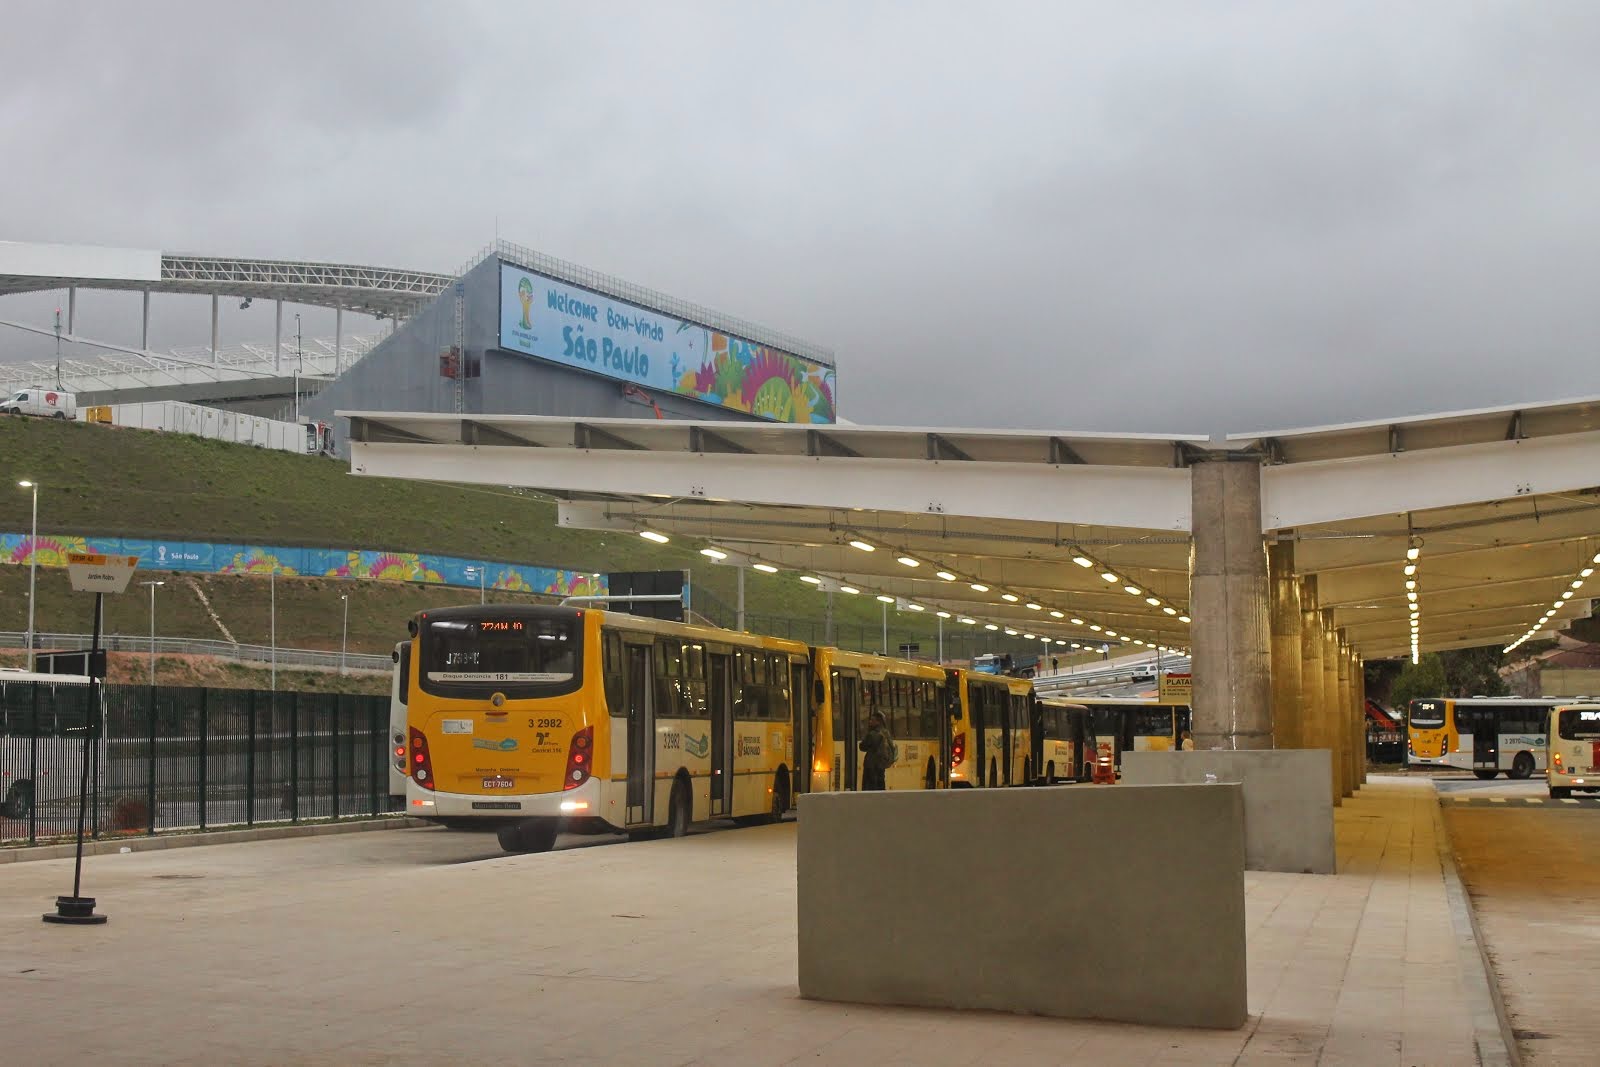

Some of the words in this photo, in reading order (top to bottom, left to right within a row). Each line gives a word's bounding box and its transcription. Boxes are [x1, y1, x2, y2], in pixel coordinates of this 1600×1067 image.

[547, 289, 598, 322] Welcome
[607, 307, 664, 342] Bem-Vindo
[562, 324, 597, 363] São
[602, 336, 649, 378] Paulo
[528, 719, 534, 728] 3
[538, 719, 562, 728] 2982
